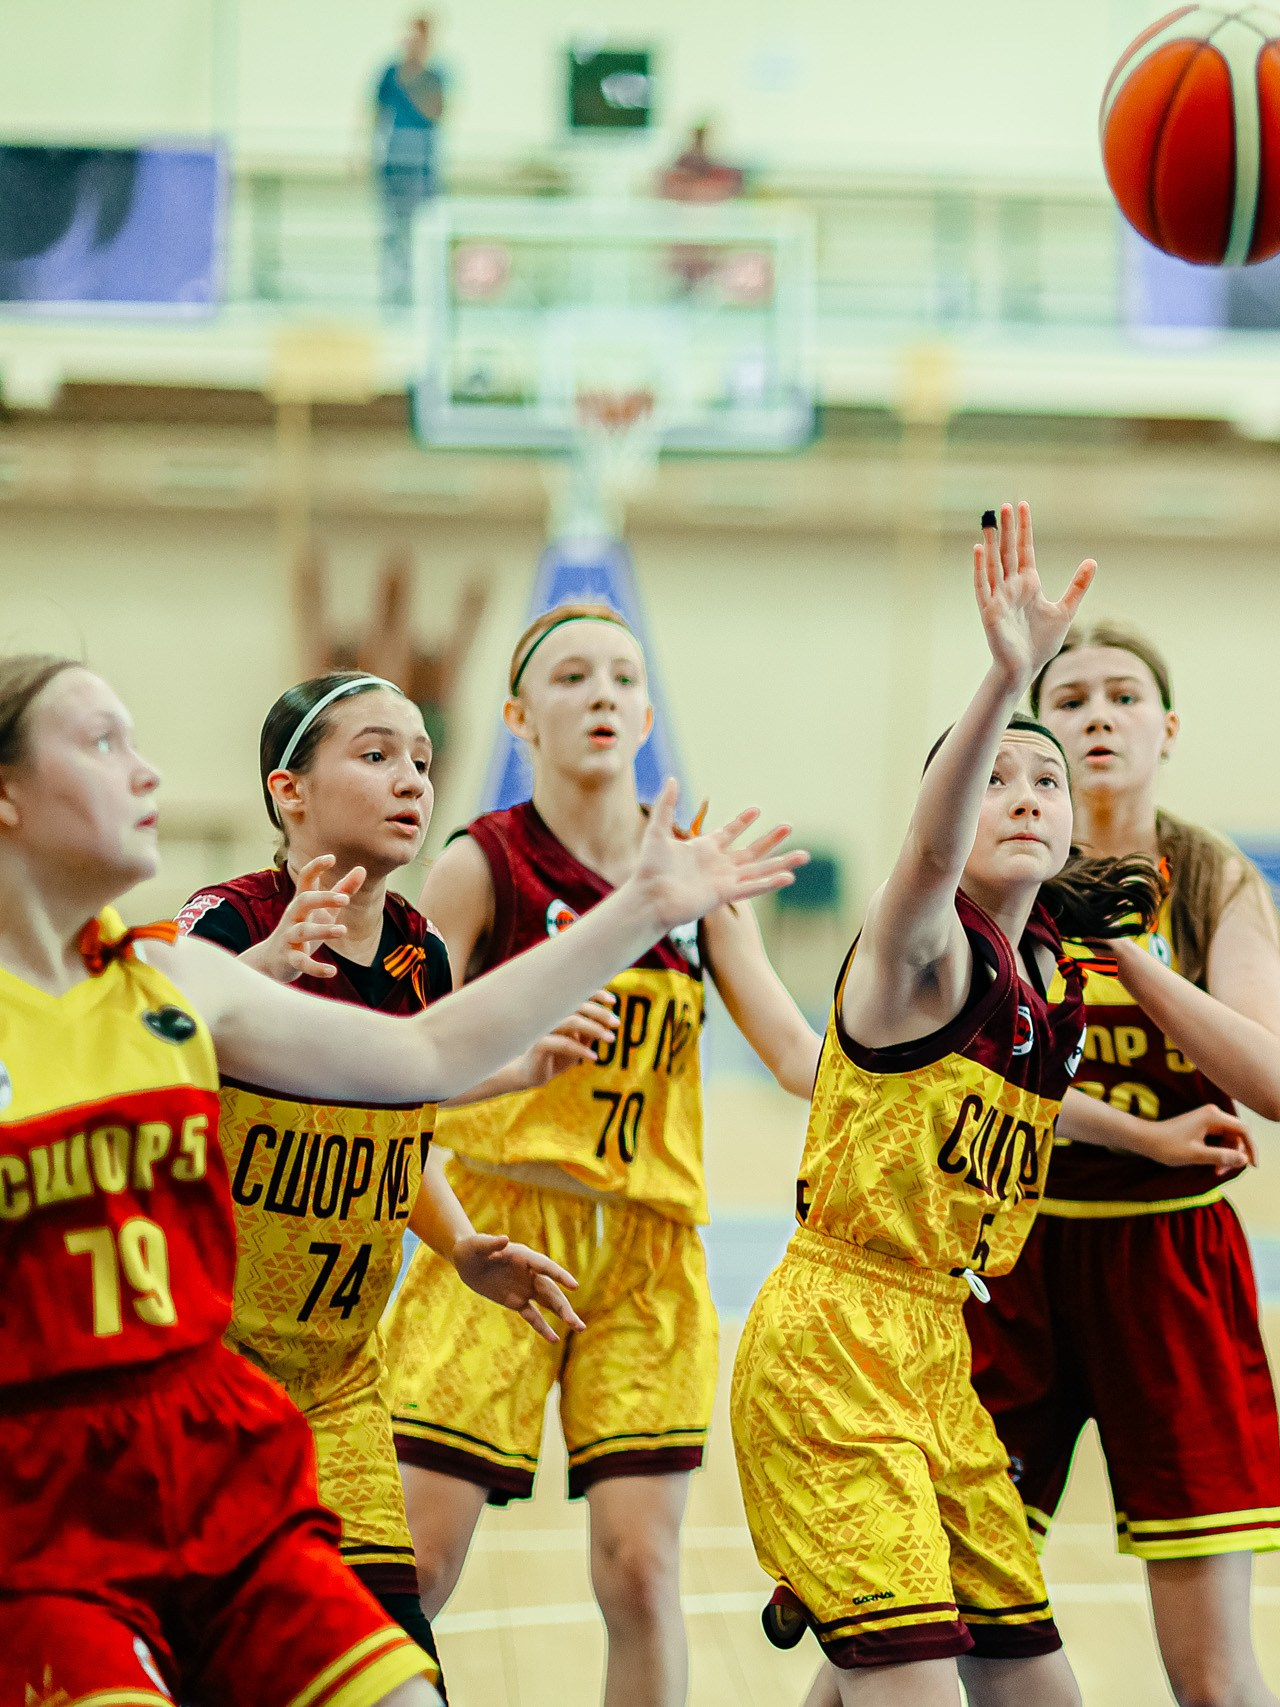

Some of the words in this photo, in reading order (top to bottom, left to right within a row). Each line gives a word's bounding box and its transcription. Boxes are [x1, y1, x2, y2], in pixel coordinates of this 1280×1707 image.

[590, 990, 652, 1070] ОР
[0, 1122, 172, 1220] СШОР
[171, 1114, 208, 1182] 5
[231, 1123, 375, 1221] СШОР
[592, 1090, 646, 1164] 70
[64, 1217, 177, 1338] 79
[296, 1241, 373, 1323] 74
